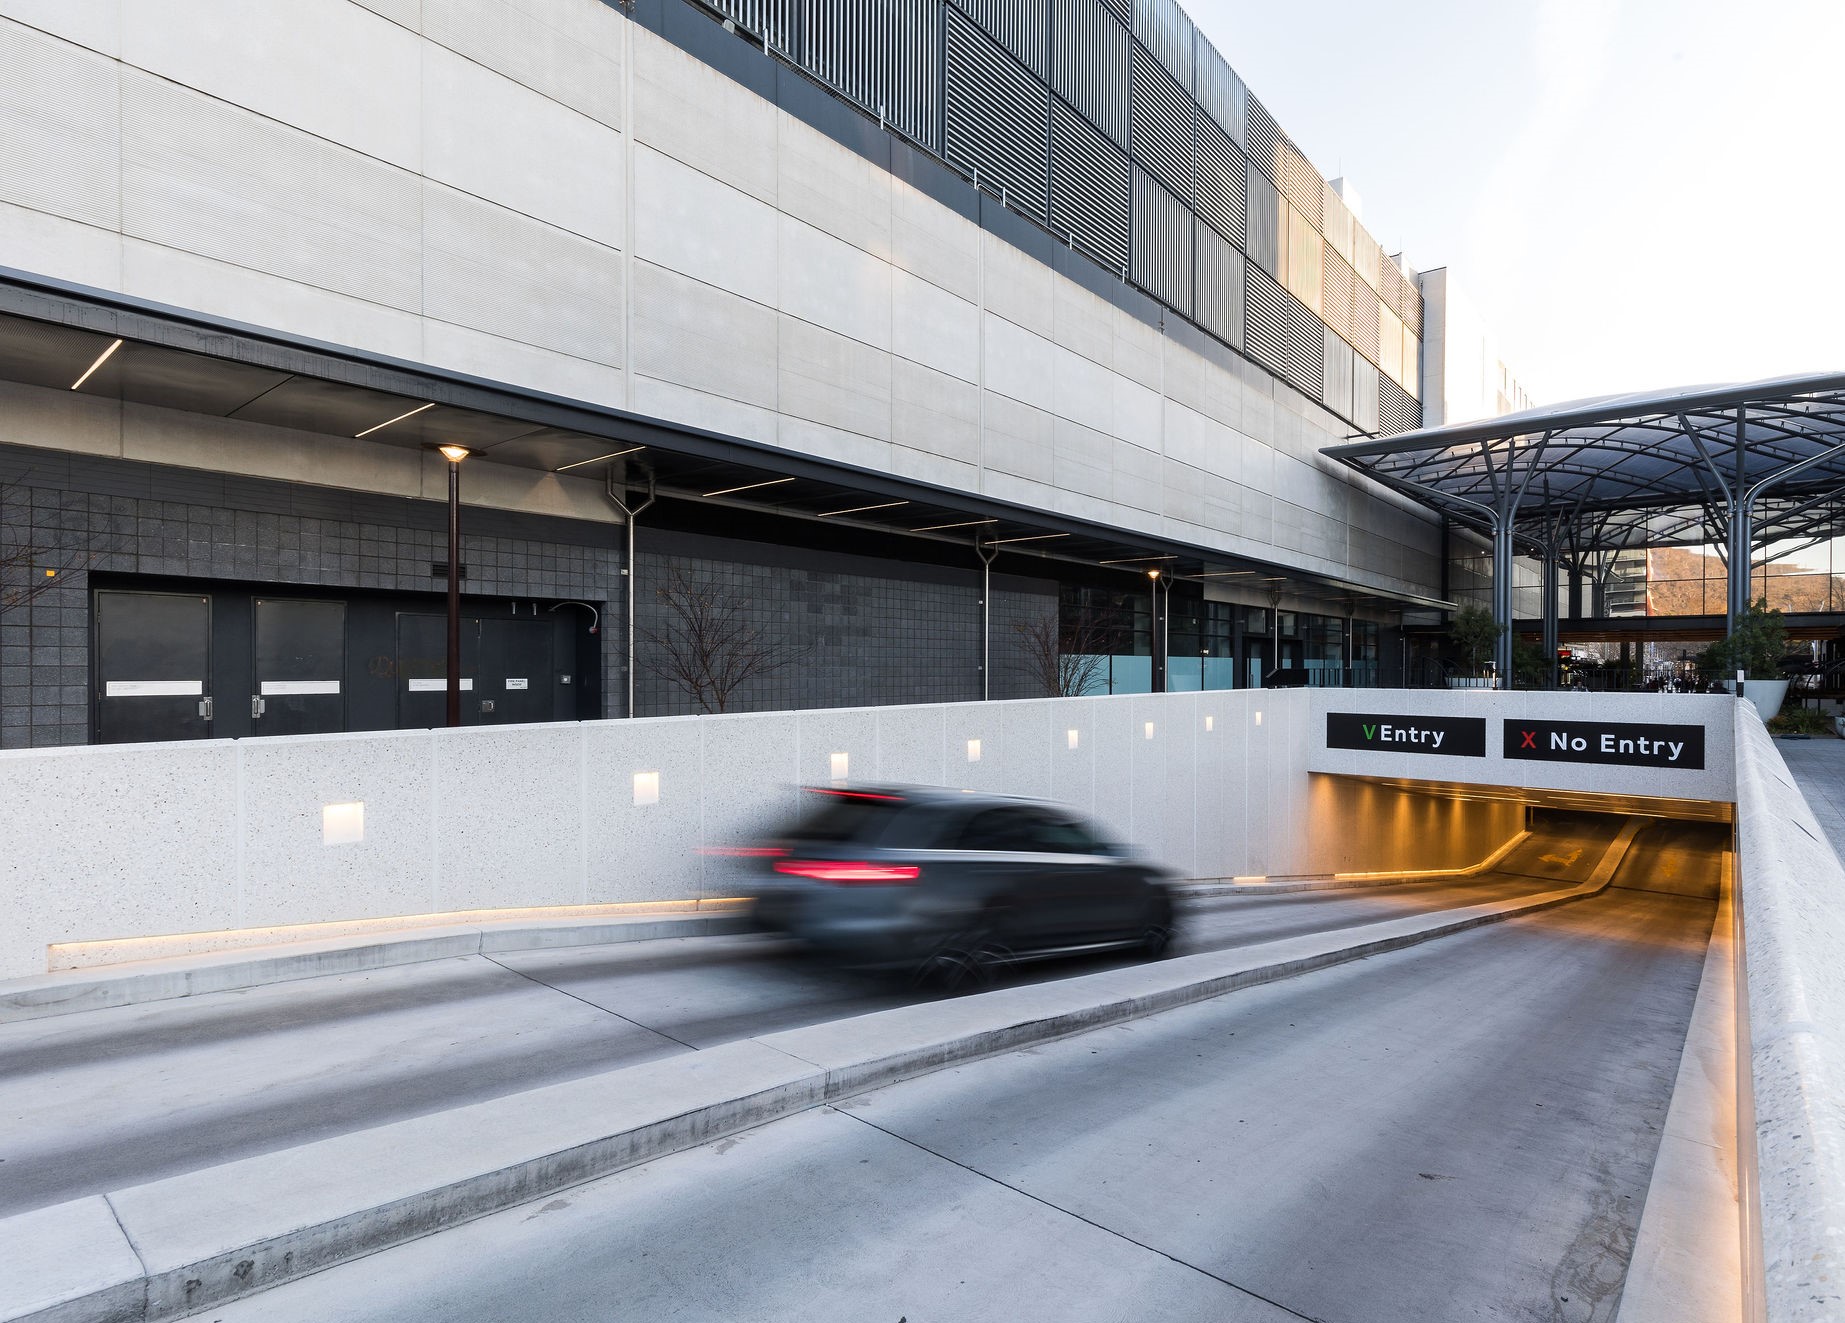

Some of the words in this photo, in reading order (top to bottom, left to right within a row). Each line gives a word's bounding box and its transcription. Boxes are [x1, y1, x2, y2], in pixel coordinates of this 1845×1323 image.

[1380, 724, 1446, 748] Entry
[1550, 731, 1588, 752] No
[1600, 733, 1685, 761] Entry
